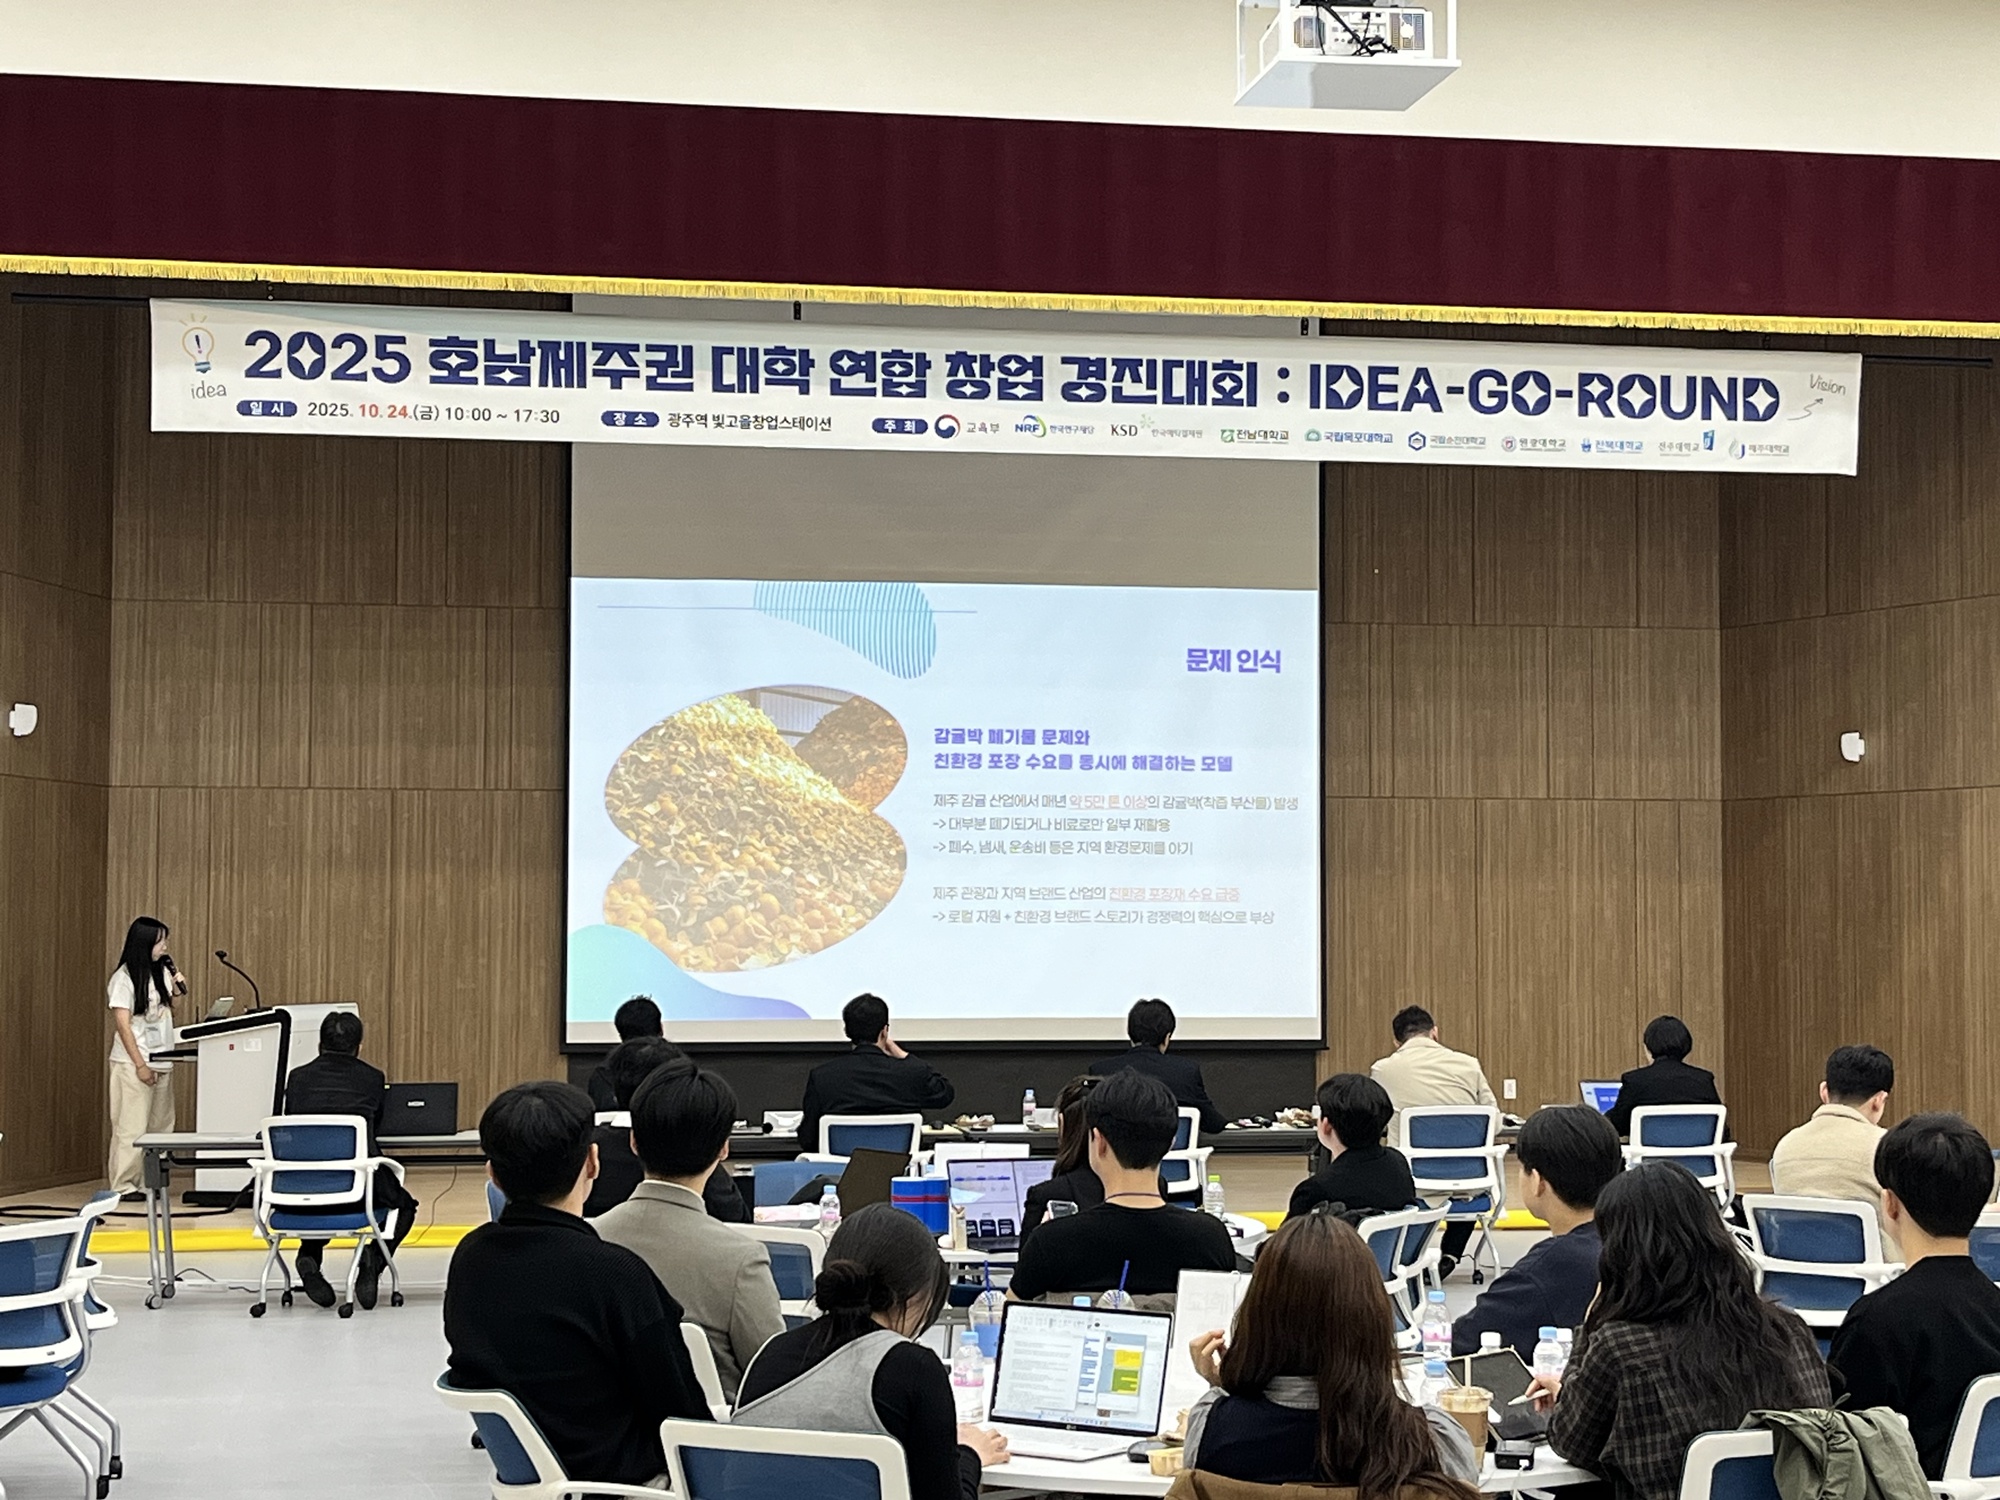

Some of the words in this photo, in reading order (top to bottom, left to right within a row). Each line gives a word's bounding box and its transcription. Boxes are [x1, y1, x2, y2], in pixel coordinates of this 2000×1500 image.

[244, 329, 412, 384] 2025
[428, 335, 694, 392] 호남제주권
[711, 345, 816, 396] 대학
[829, 348, 932, 398] 연합
[945, 350, 1044, 402] 창업
[1060, 355, 1258, 407] 경진대회
[1309, 363, 1780, 422] IDEA-GO-ROUND
[190, 381, 227, 400] idea
[1809, 373, 1847, 396] Vision
[446, 407, 491, 422] 10:00
[514, 409, 561, 424] 17:30
[667, 413, 709, 429] 광주역
[712, 413, 832, 432] 빛고을창업스테이션
[966, 421, 999, 435] 교육부
[1015, 423, 1040, 433] NRF
[1110, 424, 1138, 437] KSD
[1236, 428, 1289, 440] 전남대학교
[1324, 431, 1393, 444] 국립목포대학교
[1186, 647, 1232, 672] 문제
[1236, 649, 1282, 674] 인식
[988, 728, 1036, 746] 폐기물
[1041, 729, 1090, 746] 문제와
[934, 752, 982, 770] 친환경
[988, 753, 1020, 770] 포장
[1025, 754, 1073, 770] 수요를
[1132, 755, 1195, 772] 해결하는
[1201, 755, 1233, 773] 모델
[933, 793, 958, 807] 제주
[989, 794, 1039, 808] 산업에서
[1041, 794, 1067, 808] 매년
[1069, 795, 1082, 809] 약
[1084, 795, 1105, 809] 5만
[1123, 795, 1160, 809] 이상의
[1274, 797, 1299, 811] 발생
[948, 817, 986, 831] 대부분
[989, 817, 1051, 831] 폐기되거나
[1054, 817, 1104, 832] 비료로만
[1106, 818, 1131, 832] 일부
[1133, 818, 1171, 832] 재활용
[1009, 840, 1046, 855] 운송비
[1049, 840, 1074, 855] 등은
[1077, 840, 1102, 855] 지역
[1104, 840, 1165, 855] 환경문제를
[1168, 841, 1193, 855] 야기
[933, 886, 958, 900] 제주
[961, 886, 998, 900] 관광과
[1001, 886, 1026, 900] 지역
[1029, 886, 1067, 900] 브랜드
[1069, 887, 1106, 900] 산업의
[1188, 887, 1213, 901] 수요
[948, 909, 973, 923] 로컬
[976, 909, 1001, 923] 자원
[1014, 910, 1051, 924] 친환경
[1054, 910, 1091, 924] 브랜드
[1094, 910, 1144, 924] 스토리가
[1147, 910, 1195, 924] 경쟁력의
[1198, 911, 1247, 924] 핵심으로
[1250, 911, 1275, 925] 부상
